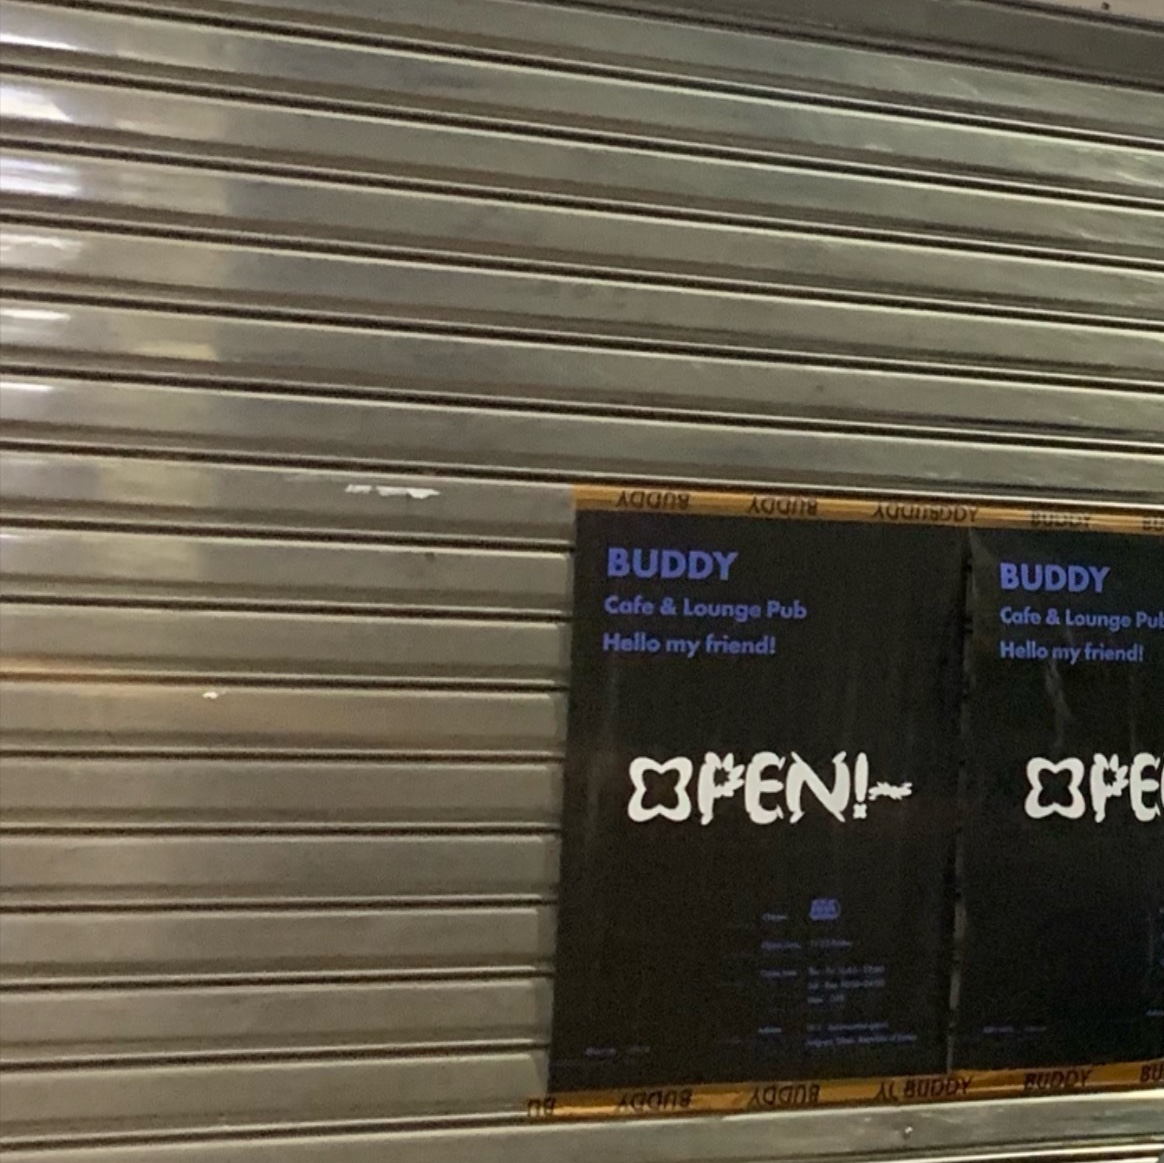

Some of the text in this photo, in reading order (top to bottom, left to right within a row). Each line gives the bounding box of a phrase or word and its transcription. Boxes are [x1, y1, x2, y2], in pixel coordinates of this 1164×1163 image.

[607, 547, 739, 580] BUDDY
[1000, 562, 1111, 593] BUDDY
[604, 595, 808, 623] Cafe & Lounge Pub
[1000, 606, 1042, 625] Cafe
[1045, 608, 1060, 626] &
[1065, 608, 1132, 632] Lounge
[603, 632, 776, 658] Hello my friend!
[1000, 640, 1145, 665] Hello my friend!
[903, 1076, 973, 1100] BUDDY
[1022, 1068, 1093, 1090] BUDDY
